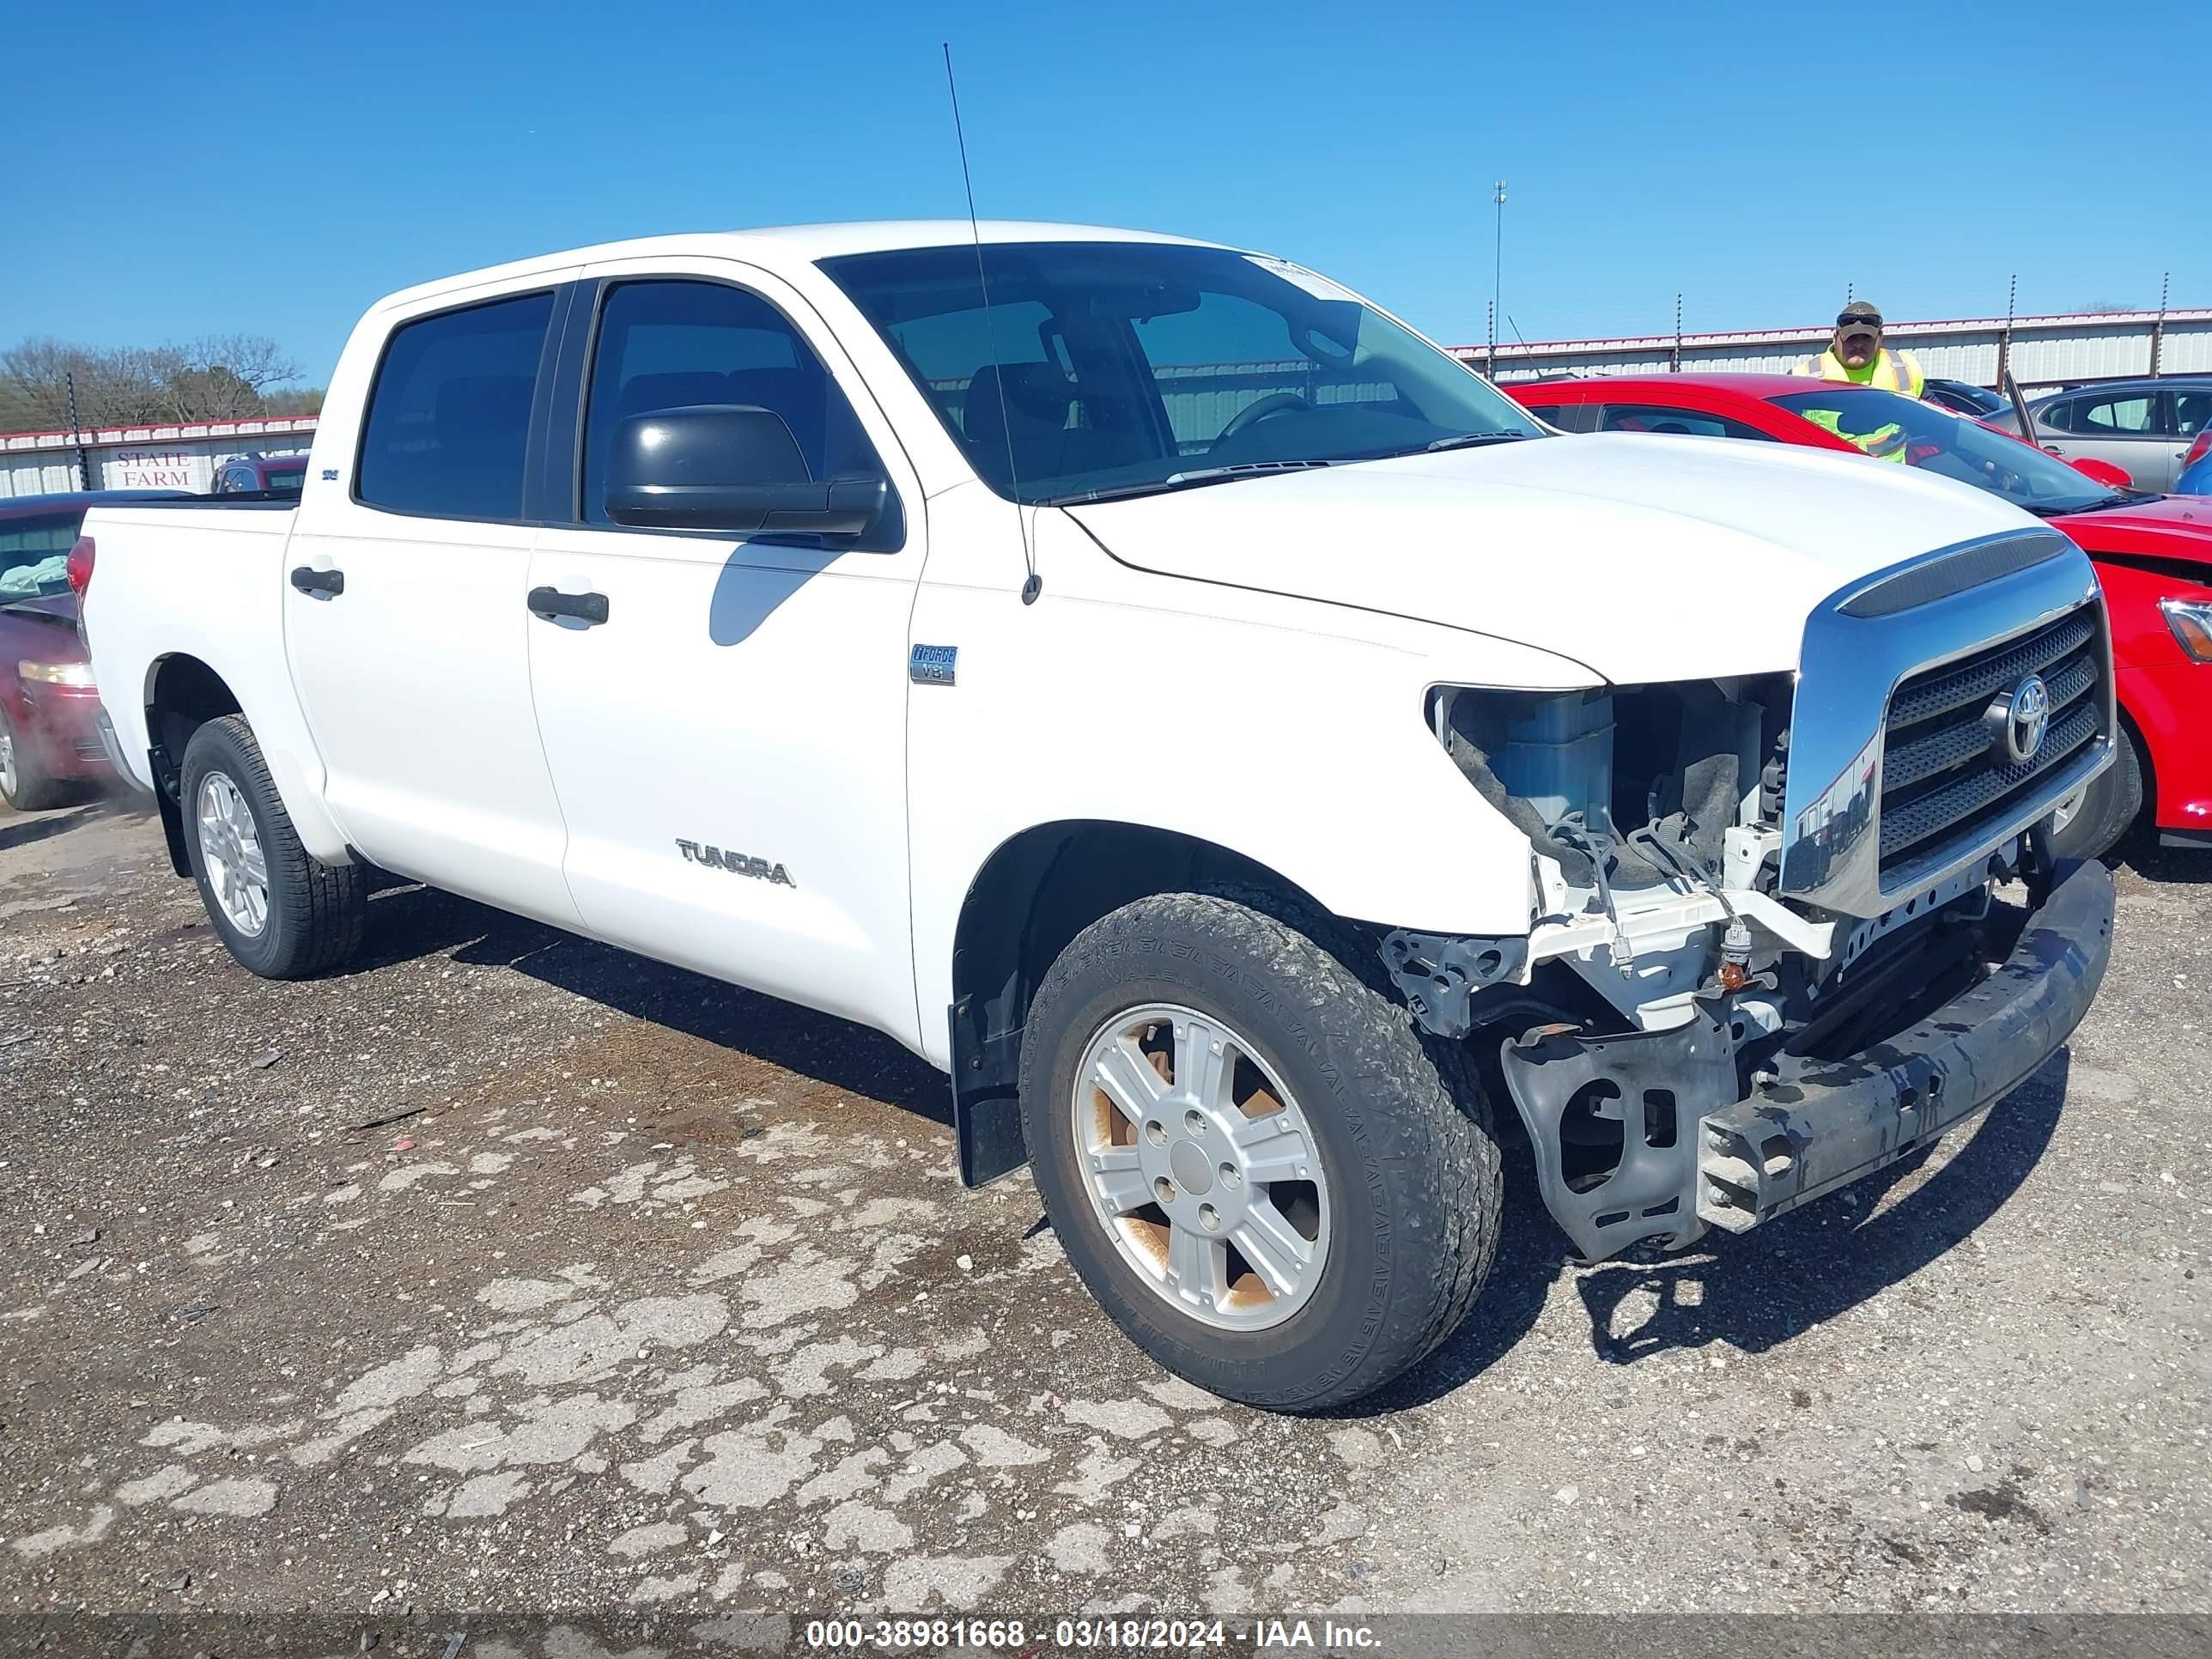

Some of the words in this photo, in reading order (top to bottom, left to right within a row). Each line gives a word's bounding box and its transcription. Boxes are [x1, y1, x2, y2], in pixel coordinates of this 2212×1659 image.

[118, 452, 191, 467] STATE
[124, 471, 190, 486] FARM
[676, 838, 797, 889] TUNDRA
